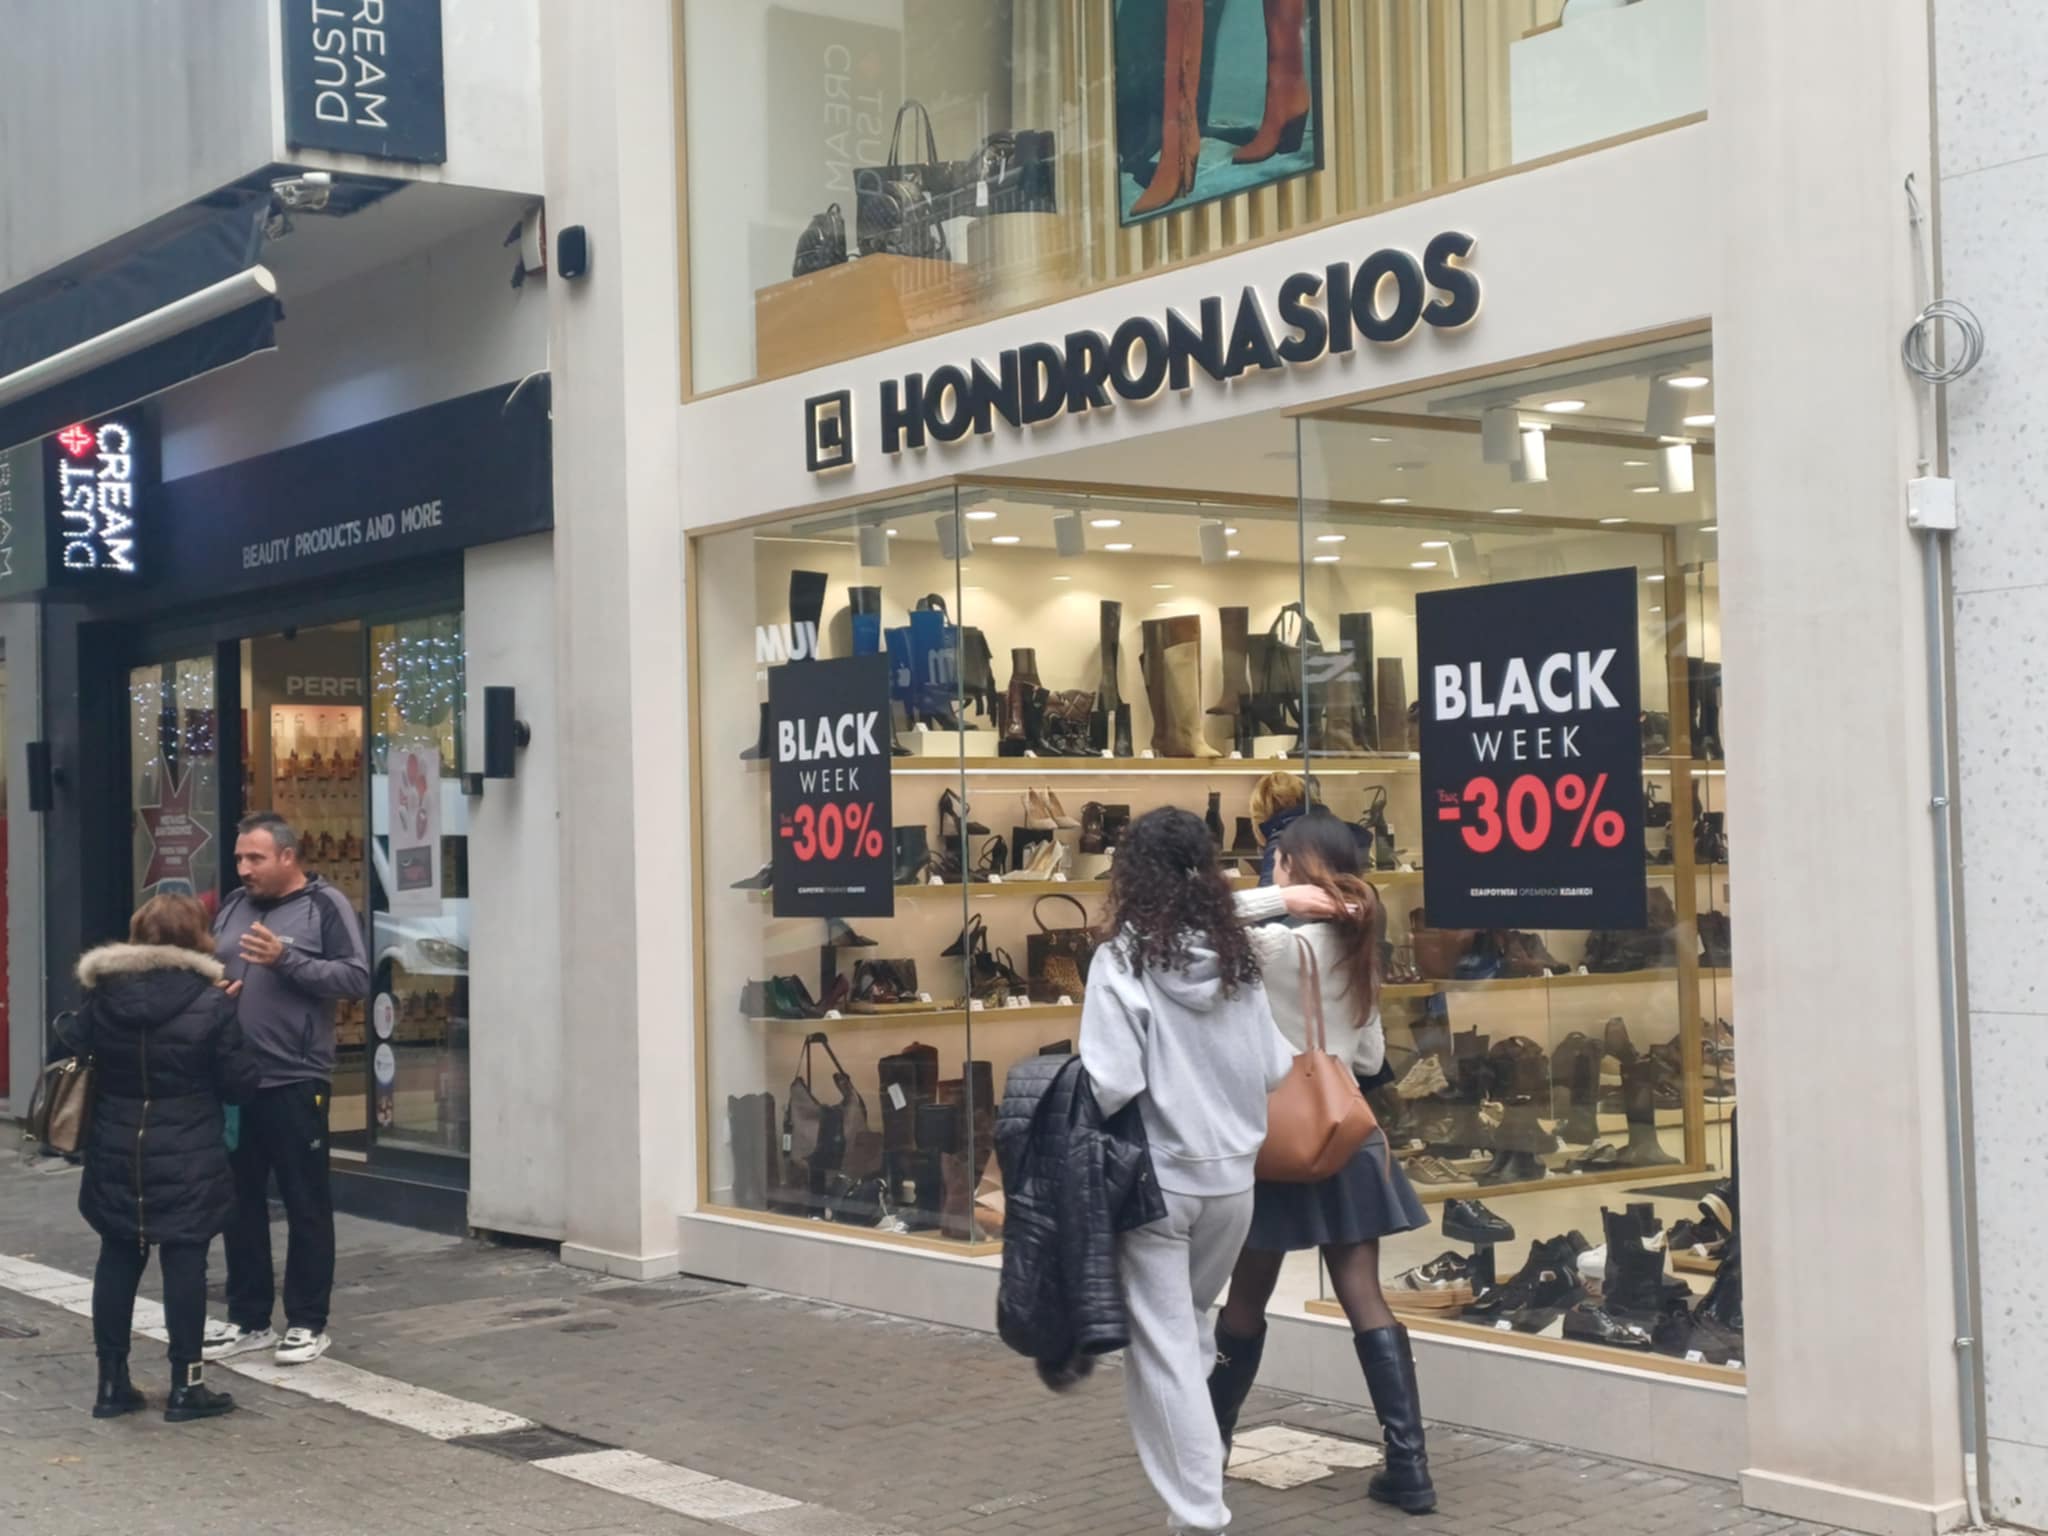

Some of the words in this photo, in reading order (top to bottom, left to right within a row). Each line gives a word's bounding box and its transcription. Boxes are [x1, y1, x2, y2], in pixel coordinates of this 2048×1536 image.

[312, 0, 349, 122] DUST
[880, 231, 1481, 453] HONDRONASIOS
[59, 458, 96, 569] DUST
[97, 423, 134, 571] CREAM
[242, 536, 290, 569] BEAUTY
[295, 520, 362, 557] PRODUCTS
[365, 513, 396, 542] AND
[401, 500, 442, 534] MORE
[286, 676, 363, 697] PERF
[1434, 648, 1620, 721] BLACK
[778, 711, 880, 762] BLACK
[1472, 726, 1581, 762] WEEK
[800, 767, 860, 793] WEEK
[1438, 773, 1626, 854] -30%
[780, 802, 884, 862] -30%
